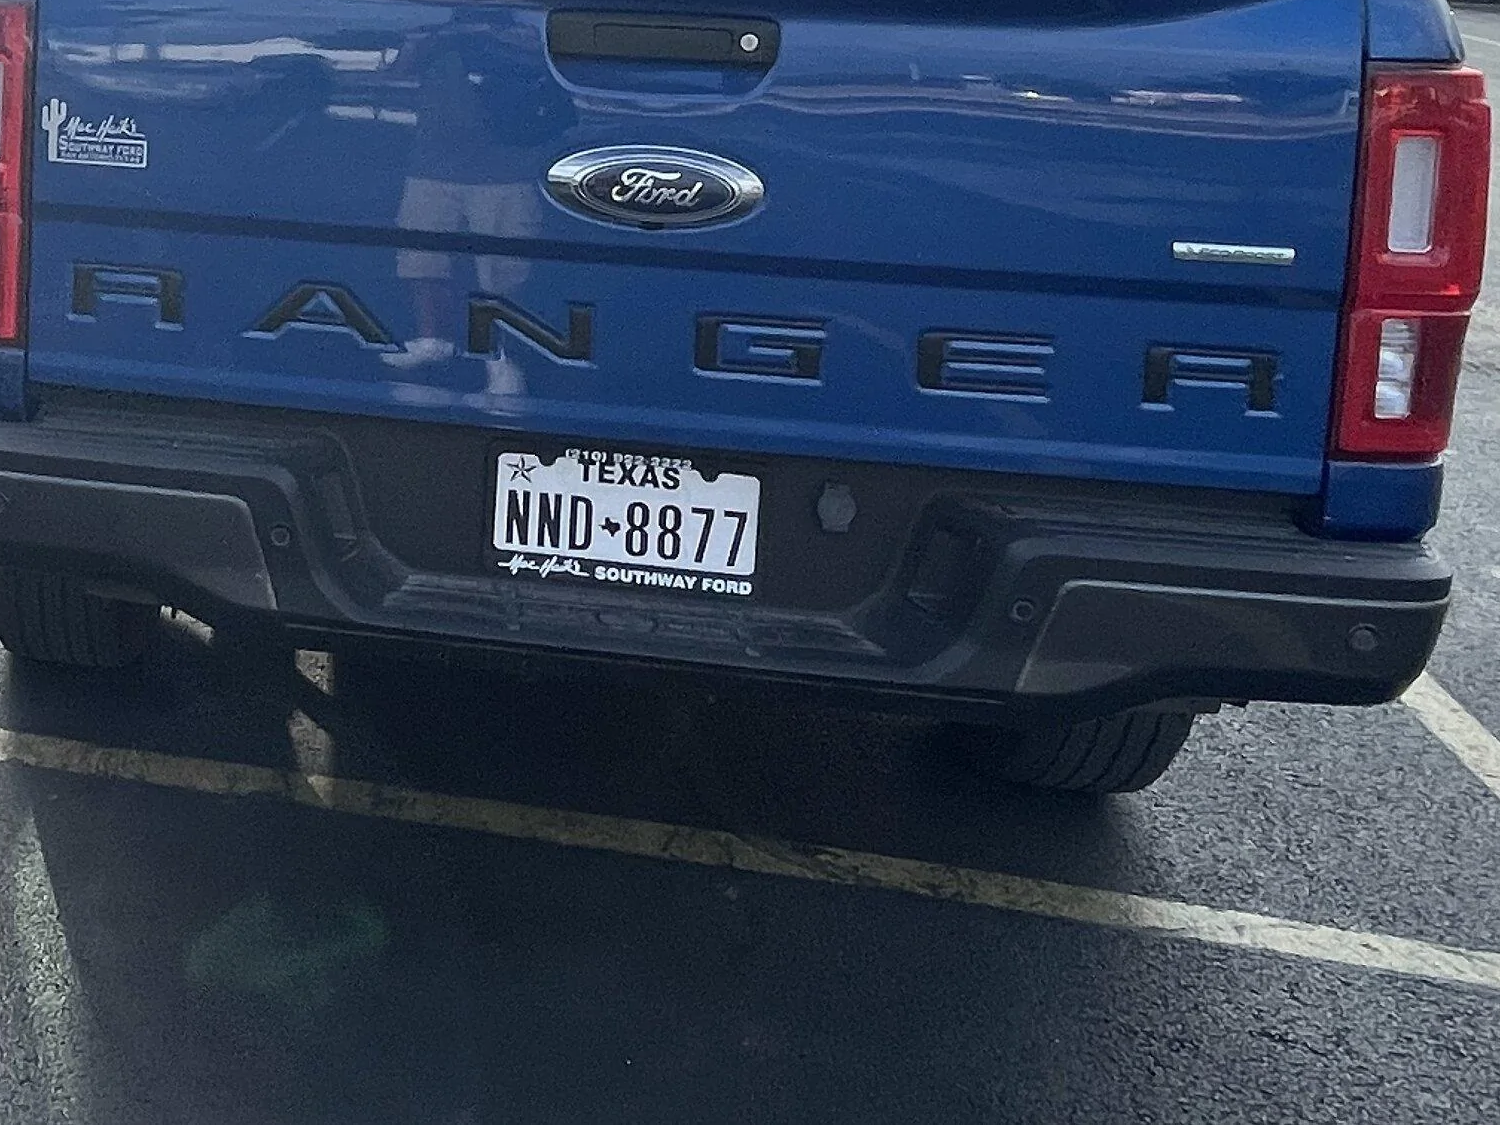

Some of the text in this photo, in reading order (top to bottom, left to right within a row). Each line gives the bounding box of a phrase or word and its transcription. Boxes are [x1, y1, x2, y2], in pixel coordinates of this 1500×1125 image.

[611, 167, 704, 207] Ford
[67, 261, 1282, 418] RANGER
[580, 461, 681, 490] TEXAS
[505, 490, 749, 567] NND 8877
[594, 566, 698, 590] SOUTHWAY
[701, 577, 752, 596] FORD
